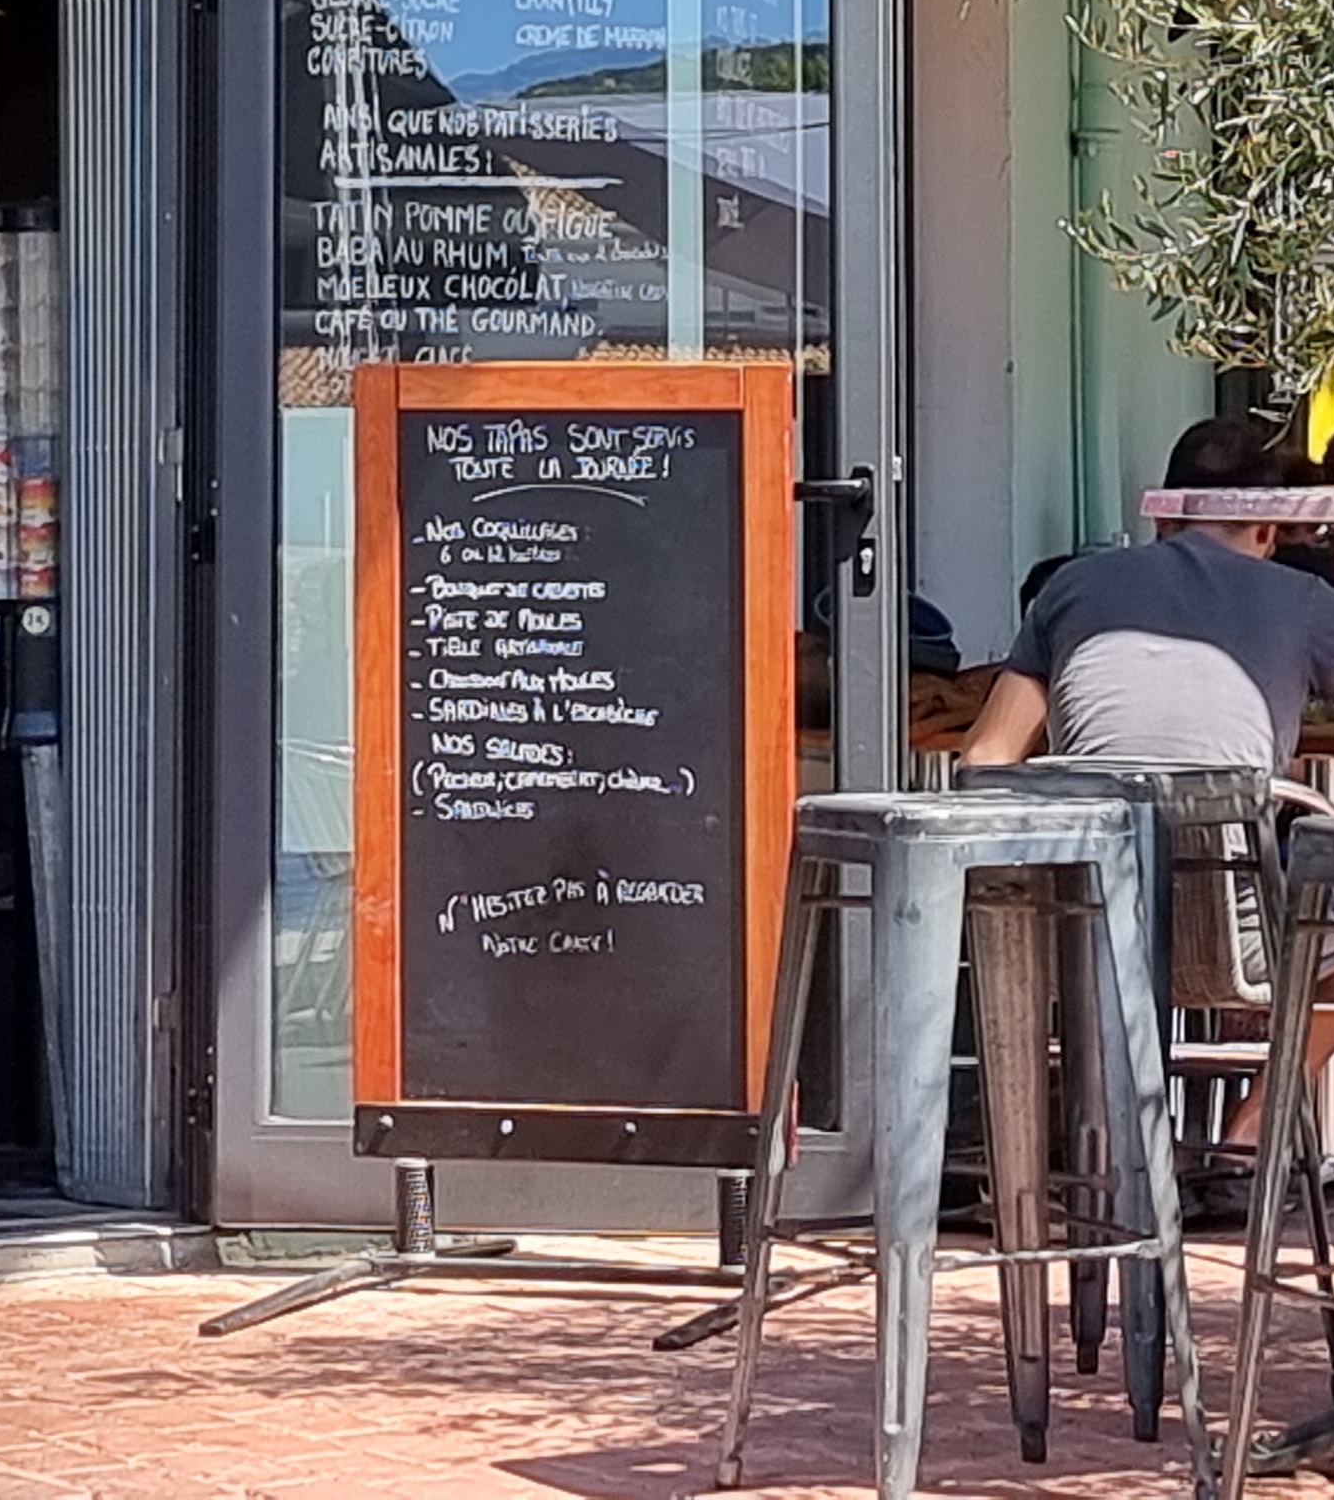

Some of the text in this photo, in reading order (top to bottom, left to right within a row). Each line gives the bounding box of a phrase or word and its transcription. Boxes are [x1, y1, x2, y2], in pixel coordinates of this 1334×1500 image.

[405, 201, 493, 236] POMME
[393, 239, 425, 266] AU
[426, 423, 473, 454] NOS
[482, 418, 549, 454] TAPAS
[567, 423, 630, 453] SONT
[439, 545, 452, 564] 6
[431, 731, 475, 756] NOS
